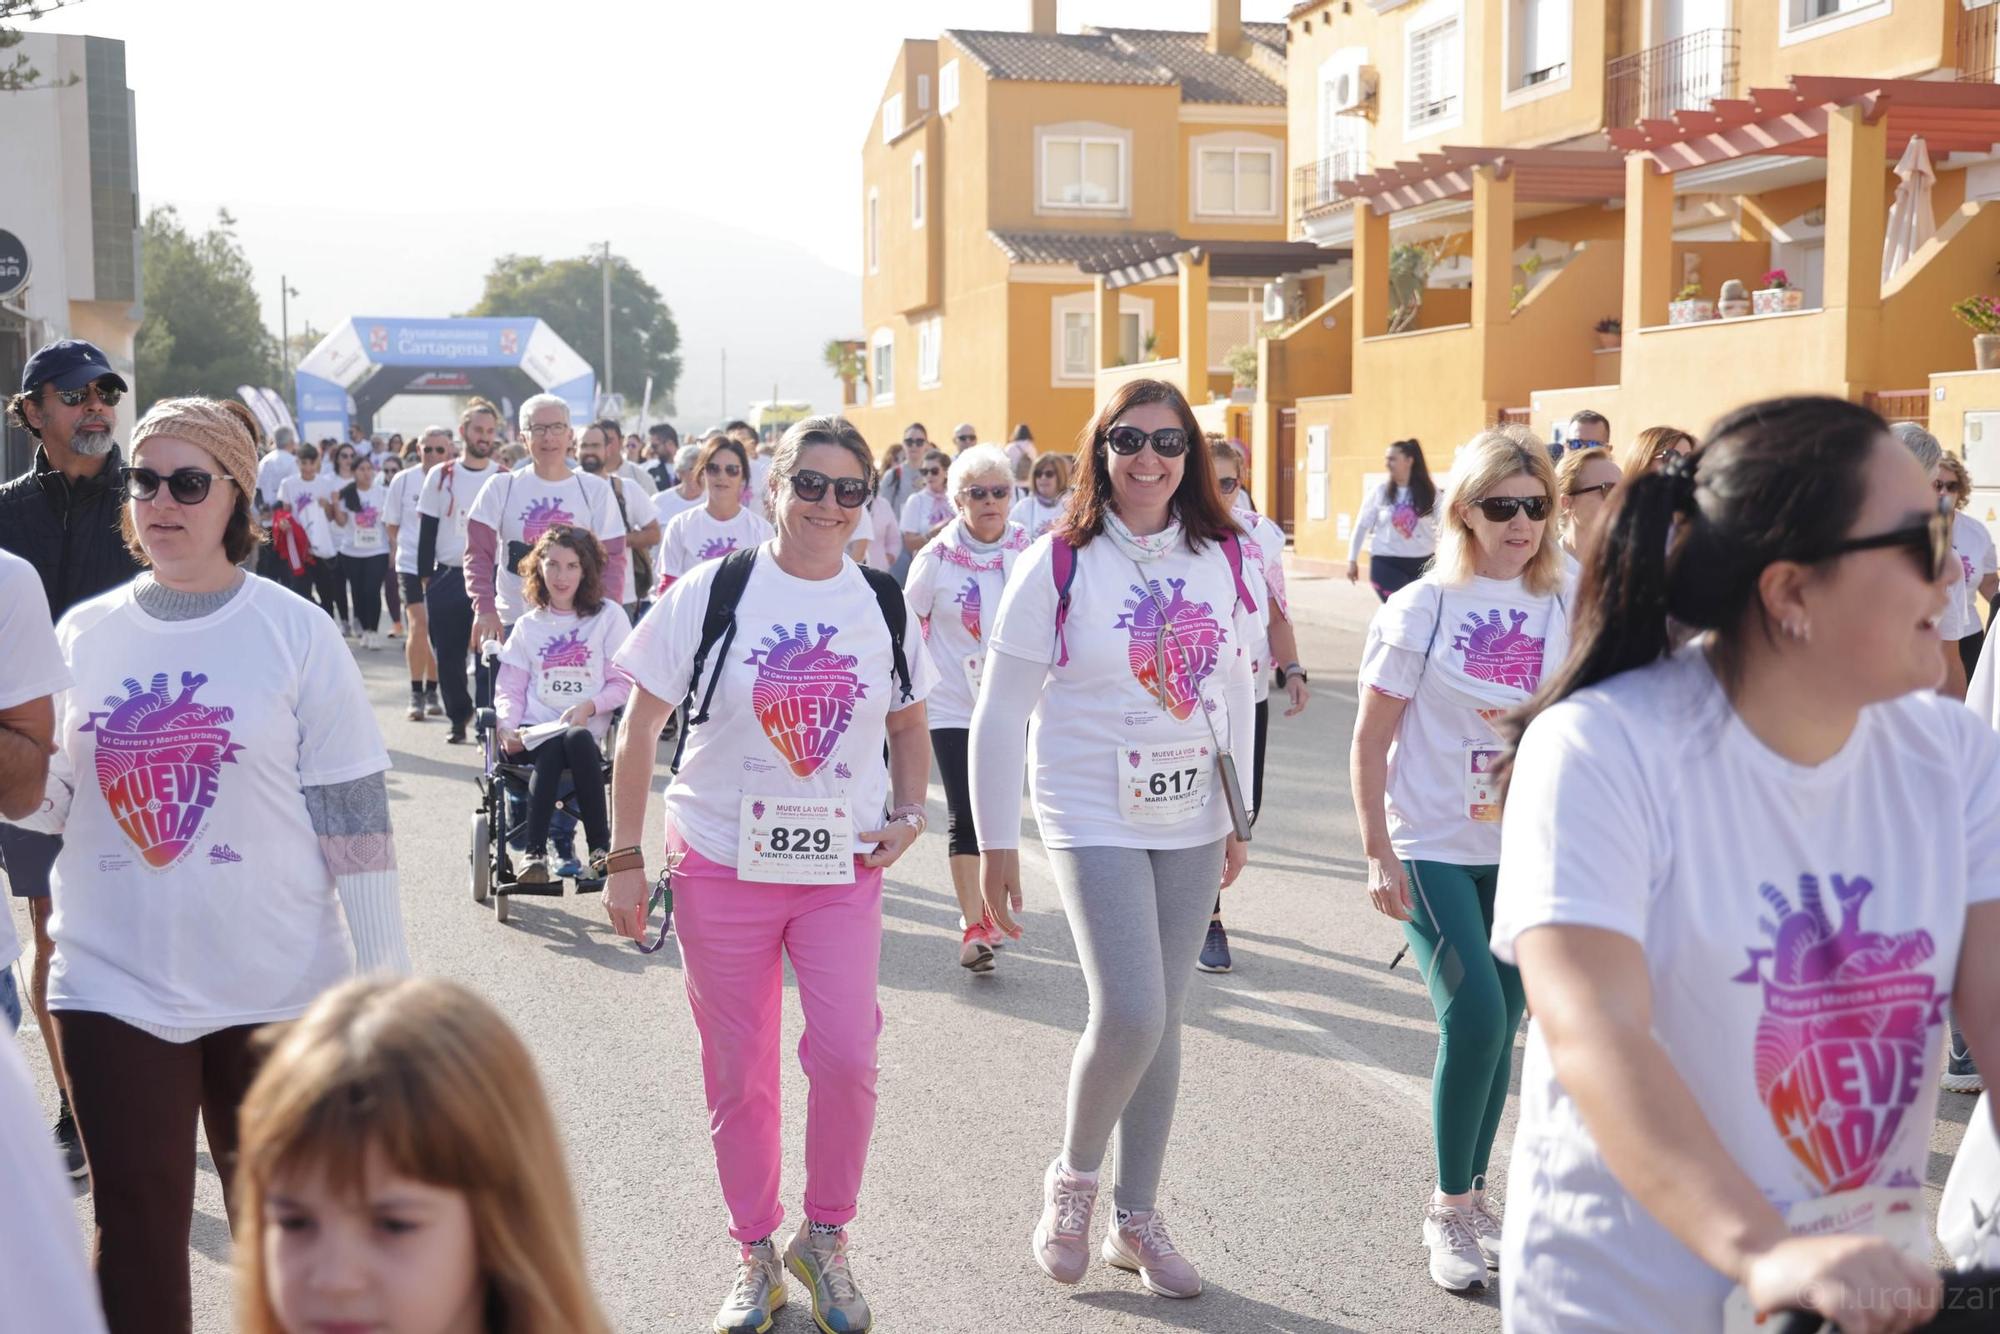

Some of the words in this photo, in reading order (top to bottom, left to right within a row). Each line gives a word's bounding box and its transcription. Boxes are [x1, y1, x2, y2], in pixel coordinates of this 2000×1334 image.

[398, 340, 489, 359] Cartagena
[770, 671, 798, 681] Carrera
[829, 674, 855, 682] Urbana
[551, 680, 583, 693] 623
[760, 696, 853, 738] MUEVE
[102, 735, 112, 744] VI
[113, 738, 149, 746] Carrera
[156, 734, 189, 745] Marcha
[190, 732, 223, 742] Urbana
[769, 728, 840, 763] VIDA
[1151, 750, 1174, 759] MUEVE
[1149, 768, 1198, 796] 617
[108, 764, 220, 821] MUEVE
[148, 800, 162, 810] la
[776, 804, 801, 813] MUEVE
[802, 806, 812, 814] LA
[813, 806, 829, 814] VIDA
[118, 803, 206, 851] VIDA
[770, 827, 831, 853] 829
[760, 851, 793, 860] VIENTOS
[795, 853, 839, 861] CARTAGENA
[1769, 1043, 1923, 1138] MUEVE
